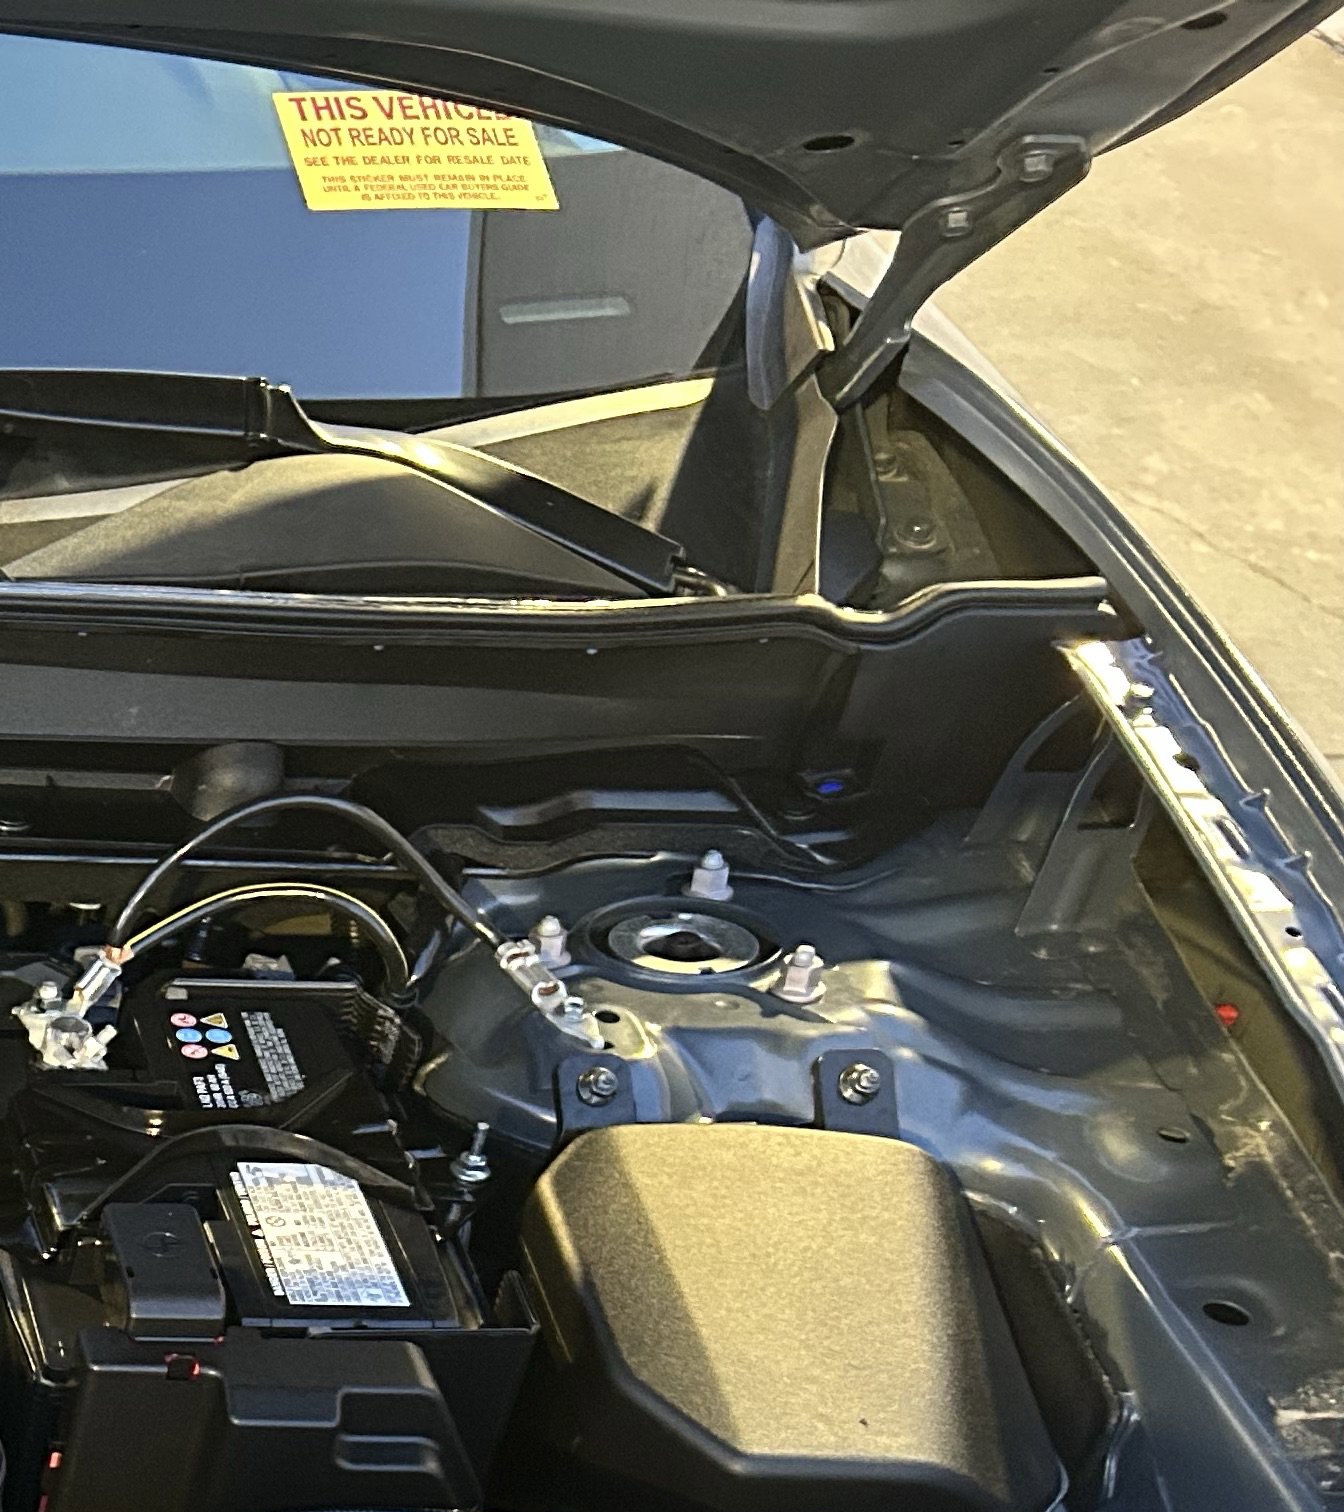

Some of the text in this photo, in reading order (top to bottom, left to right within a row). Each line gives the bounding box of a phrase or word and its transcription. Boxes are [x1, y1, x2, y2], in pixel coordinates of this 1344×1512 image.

[288, 96, 368, 120] THIS
[301, 127, 519, 147] NOT READY FOR SALE
[304, 155, 530, 166] SEE THE DEALER FOR RESALE DATE
